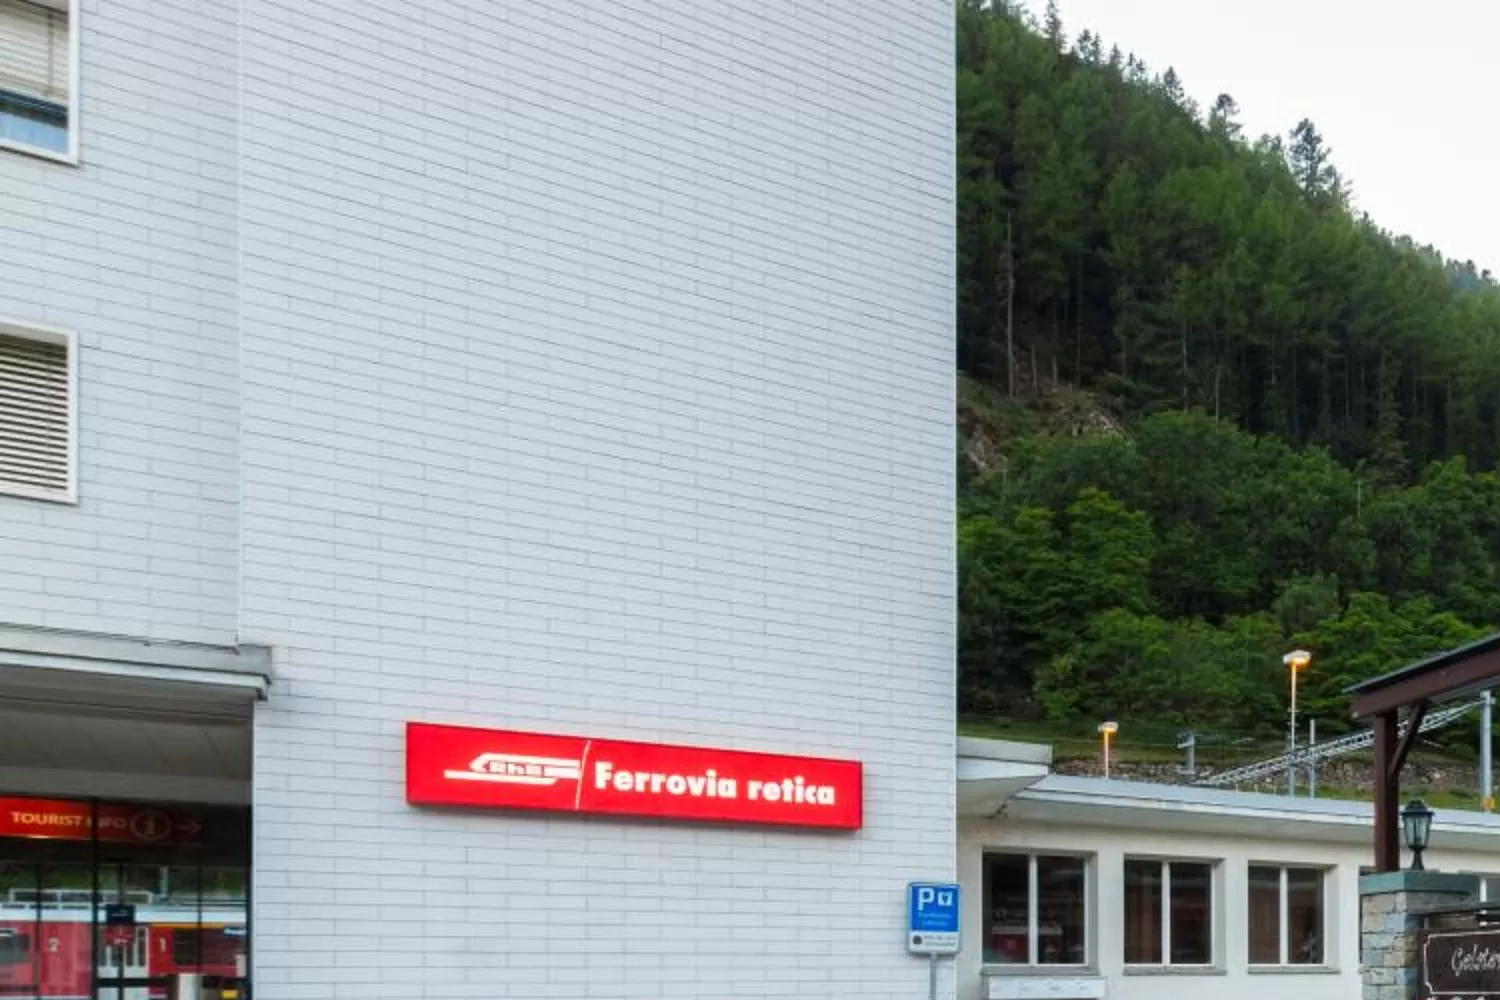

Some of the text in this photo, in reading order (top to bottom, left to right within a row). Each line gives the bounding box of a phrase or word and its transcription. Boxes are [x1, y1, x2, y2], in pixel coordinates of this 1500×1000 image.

[595, 762, 835, 805] Ferrovia retica
[10, 811, 83, 827] TOURIST
[86, 815, 128, 829] IFO
[918, 888, 934, 911] P
